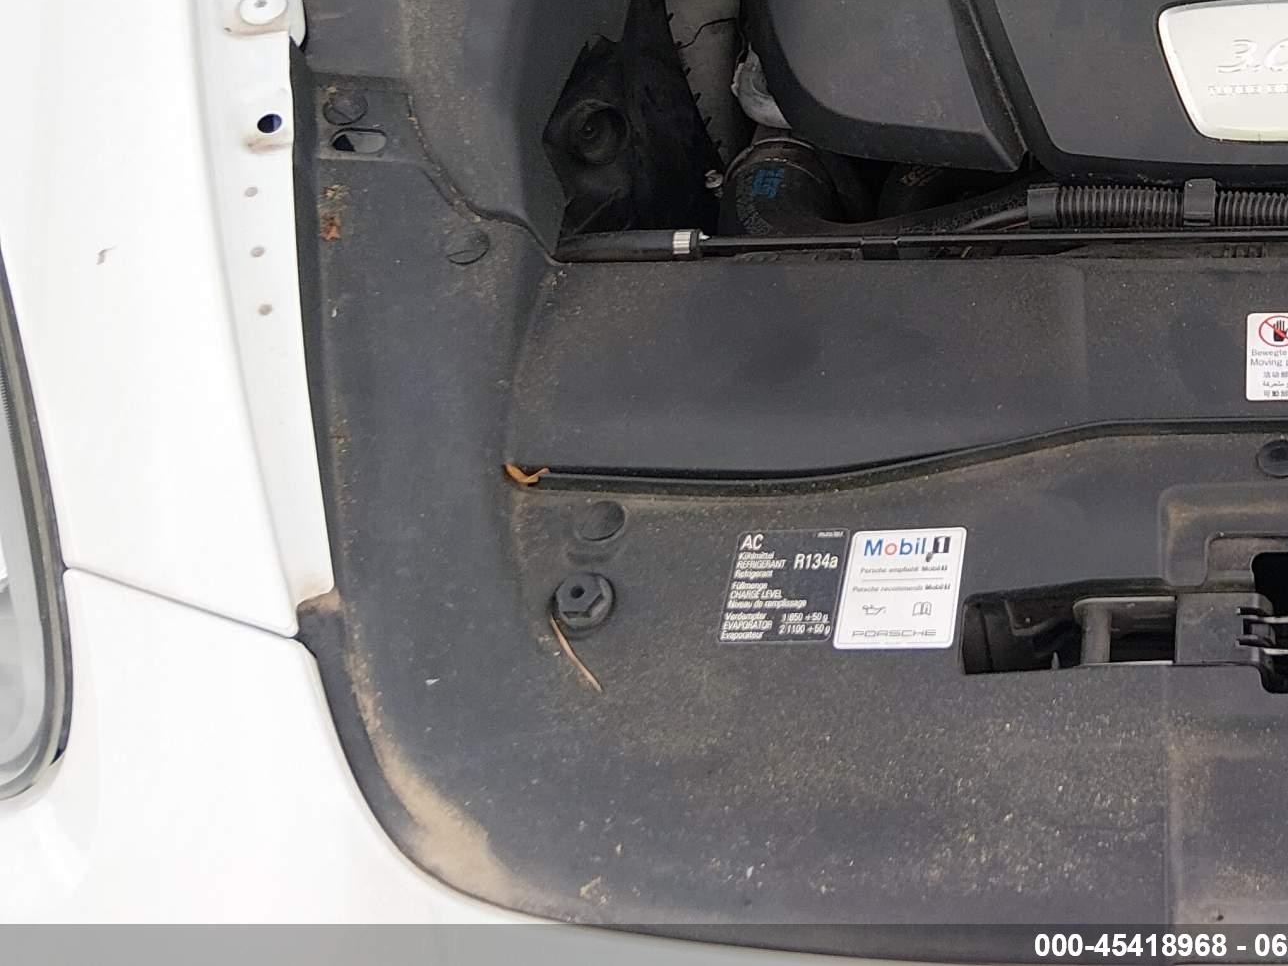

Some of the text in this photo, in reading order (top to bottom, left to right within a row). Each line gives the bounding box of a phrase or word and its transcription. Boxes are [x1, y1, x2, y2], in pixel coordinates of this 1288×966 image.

[1252, 349, 1287, 357] Bewegte
[1251, 359, 1282, 367] Moving
[740, 534, 764, 550] AC
[863, 538, 927, 556] Mobil
[736, 554, 839, 570] REFRIGERANT R134a
[729, 589, 782, 599] CHARGE LEVEL
[722, 620, 773, 630] EVAPORATOR
[852, 629, 937, 638] PORSCHE
